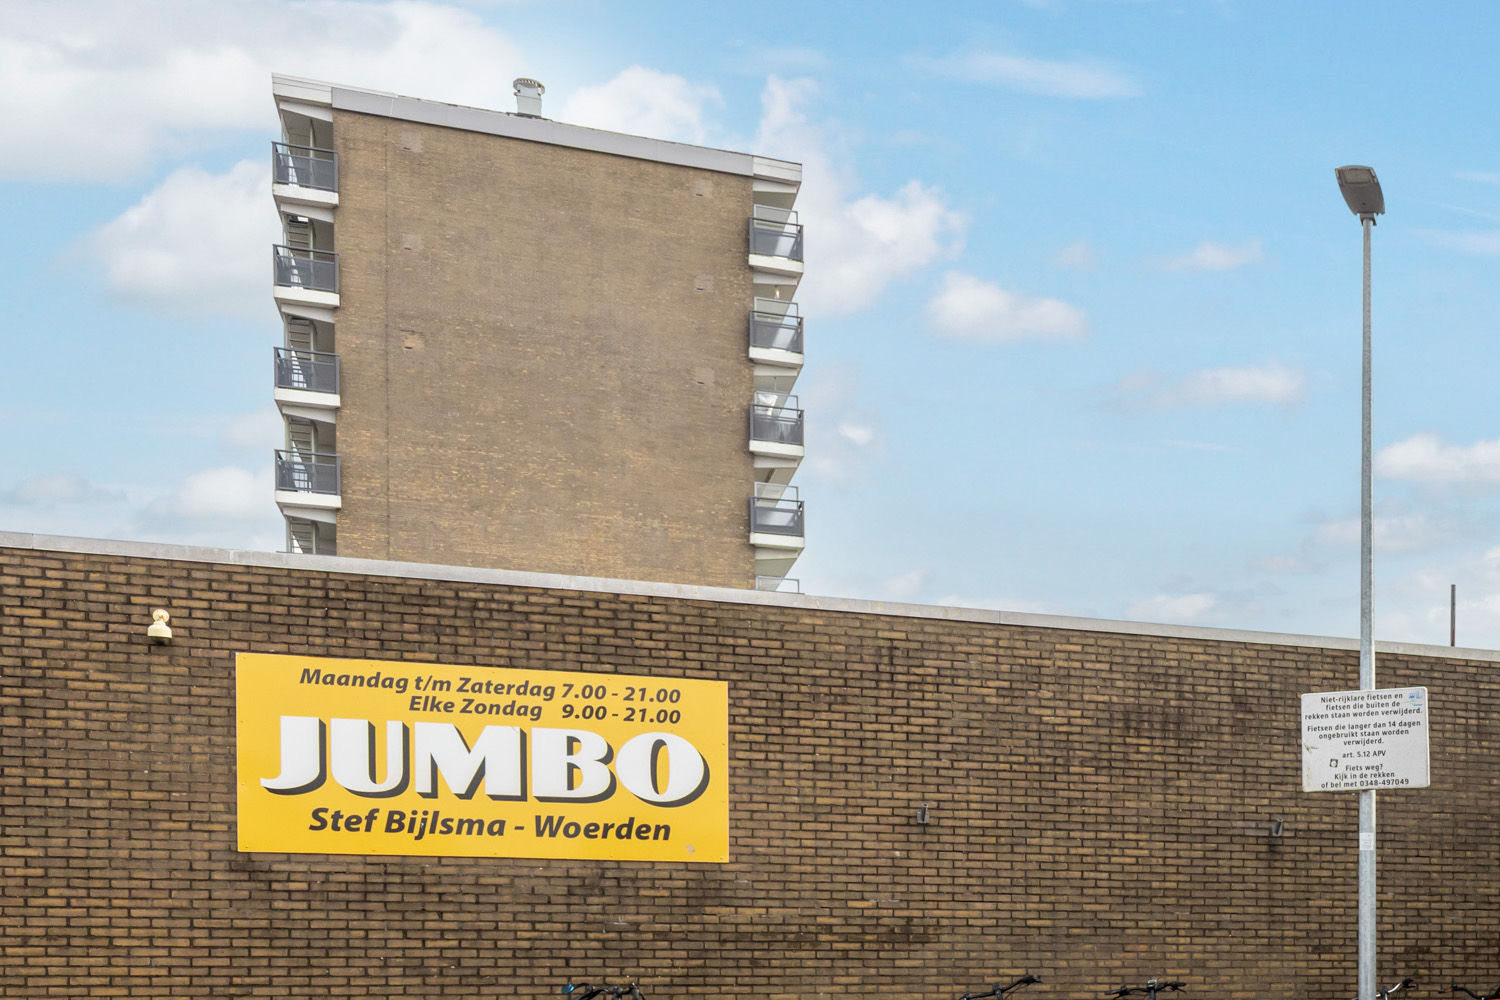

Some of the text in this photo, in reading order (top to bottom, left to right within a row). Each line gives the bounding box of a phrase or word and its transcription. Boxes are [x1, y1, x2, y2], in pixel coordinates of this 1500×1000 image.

[300, 668, 409, 694] Maandag
[415, 675, 451, 691] t/m
[456, 677, 556, 701] Zaterdag
[561, 683, 607, 700] 7.00
[623, 686, 681, 703] 21.00
[1320, 695, 1365, 704] Niet-rijklare
[409, 695, 455, 713] Elke
[459, 698, 543, 721] Zondag
[562, 704, 607, 720] 9.00
[623, 707, 681, 724] 21.00
[1325, 703, 1351, 711] fietsen
[1366, 701, 1390, 709] buiten
[1304, 707, 1423, 720] rekken staan worden verwijderd.
[1348, 722, 1371, 731] langer
[1398, 719, 1421, 728] dagen
[1318, 728, 1409, 740] ongebruikt staan worden
[1343, 738, 1384, 746] verwijderd.
[260, 715, 711, 808] JUMBO
[1365, 763, 1383, 772] weg?
[1359, 778, 1409, 787] 0348-497049
[308, 807, 379, 834] Stef
[385, 810, 506, 841] Bijlsma
[534, 813, 672, 841] Woerden
